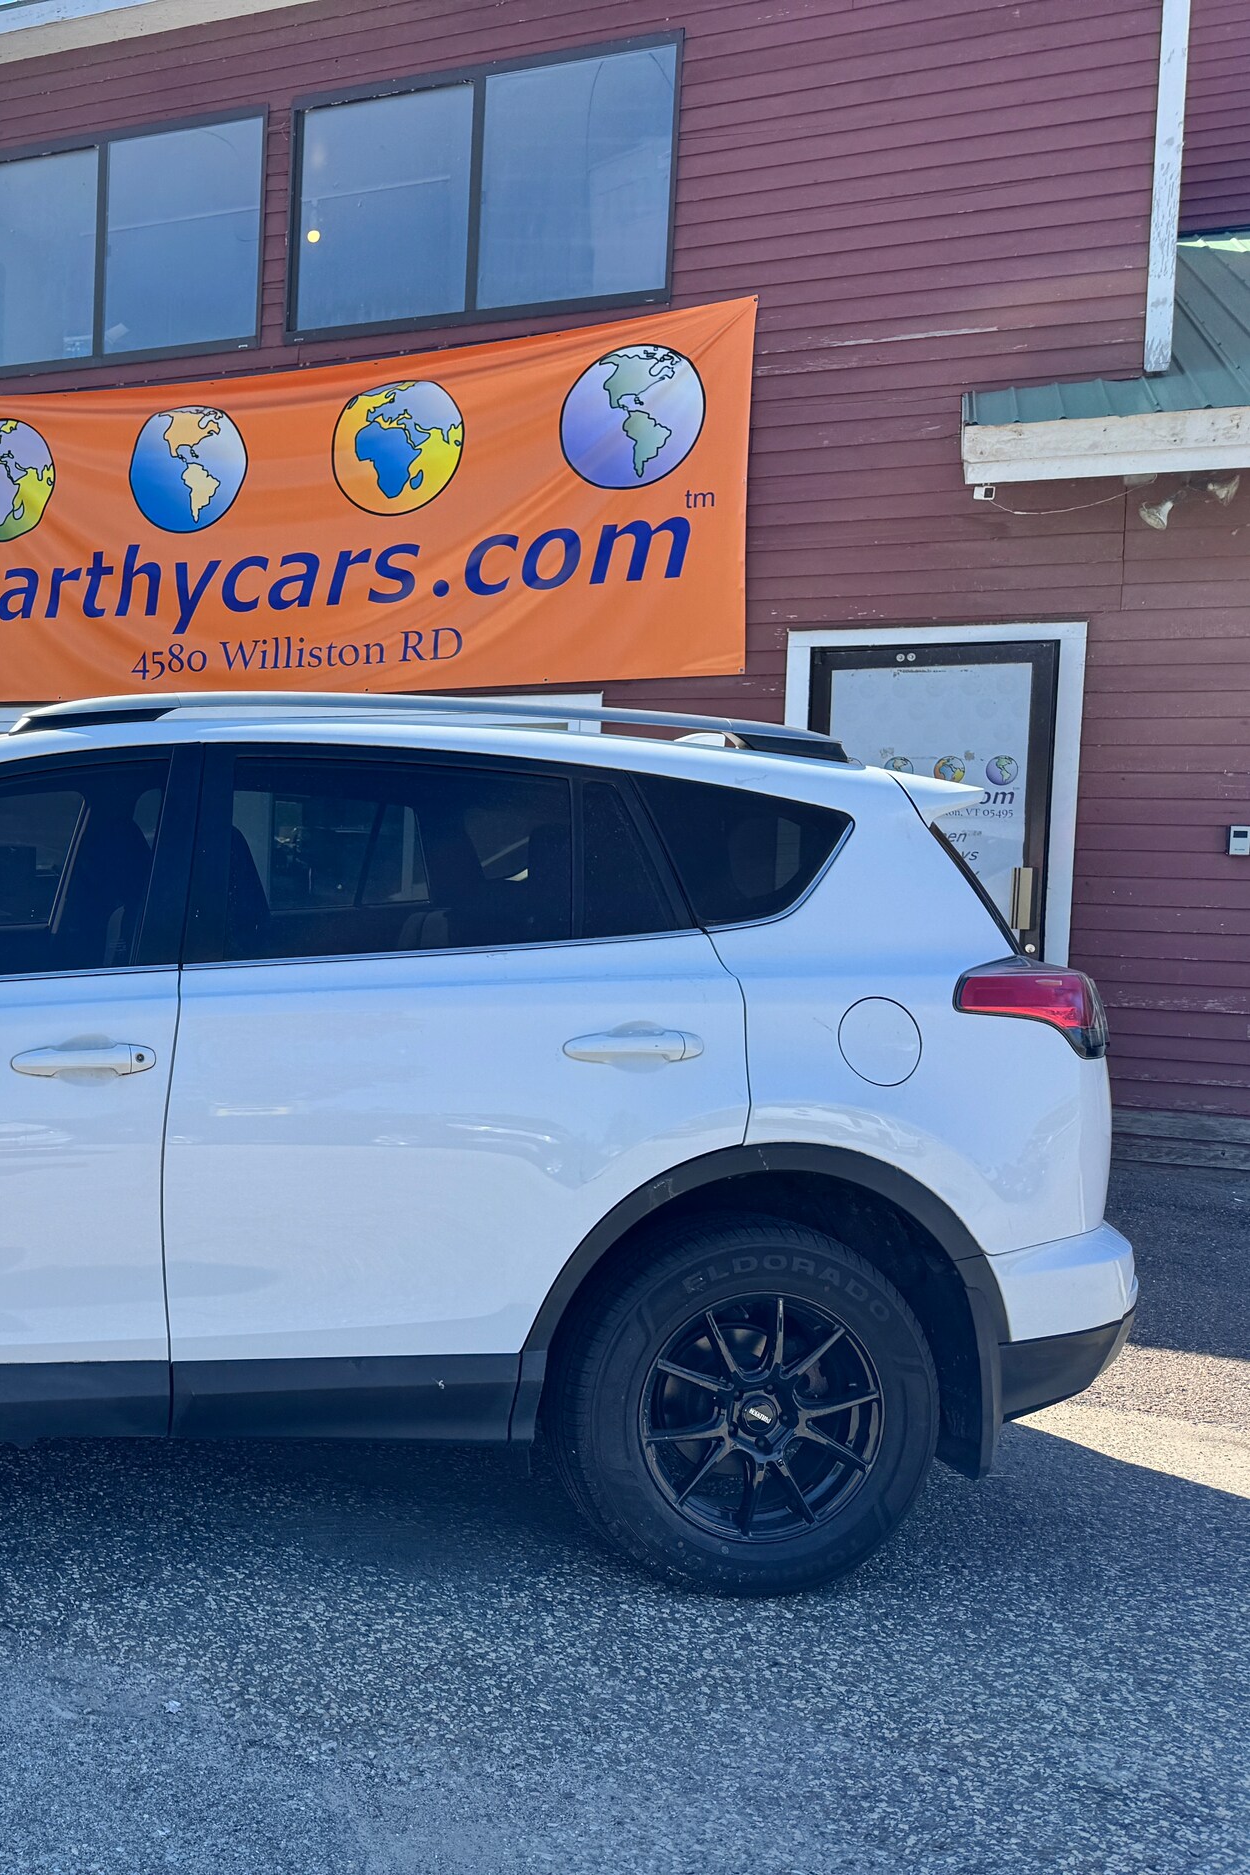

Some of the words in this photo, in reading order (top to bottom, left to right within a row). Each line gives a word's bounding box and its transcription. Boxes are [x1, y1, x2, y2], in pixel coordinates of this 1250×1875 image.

[131, 643, 208, 681] 4580
[219, 636, 385, 671] Williston
[398, 627, 463, 663] RD
[966, 808, 980, 817] VT
[982, 809, 1013, 818] 05495
[682, 1254, 890, 1322] ELDORADO
